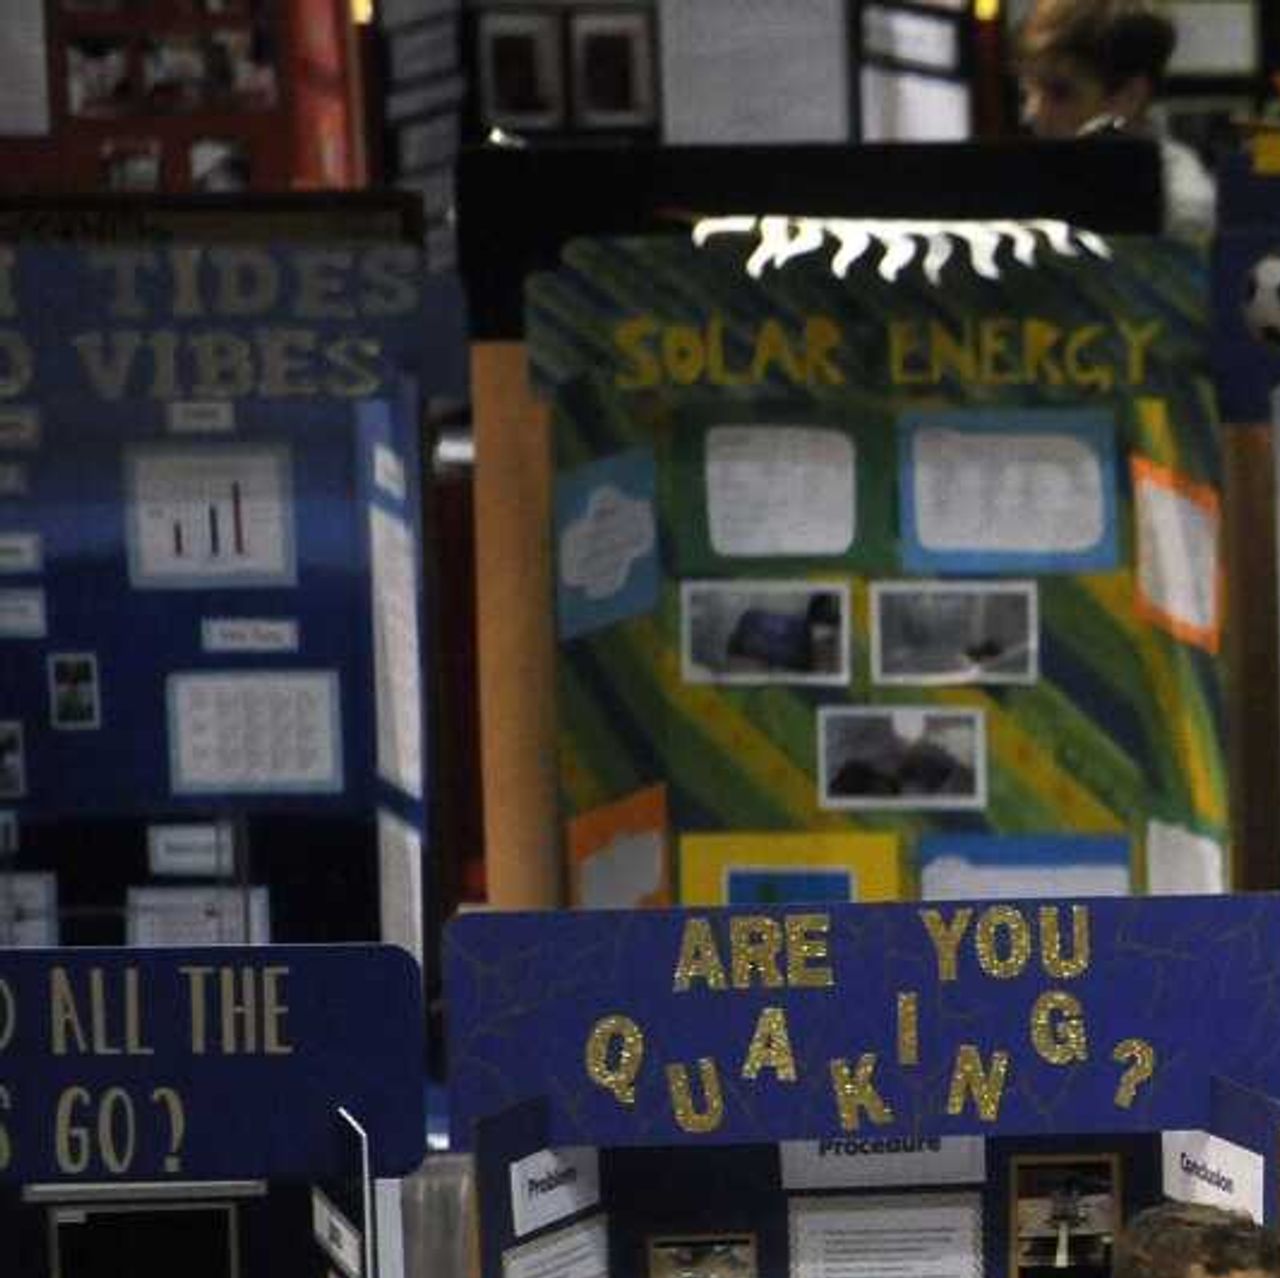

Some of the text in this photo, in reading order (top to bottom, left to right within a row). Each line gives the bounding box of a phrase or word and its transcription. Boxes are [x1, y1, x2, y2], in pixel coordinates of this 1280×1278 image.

[92, 244, 419, 318] TIDES
[71, 327, 384, 398] VIBES
[614, 314, 1161, 392] SOLAR ENERGY
[673, 906, 1094, 993] ARE YOU
[51, 966, 155, 1056] ALL
[180, 966, 294, 1056] THE
[56, 1085, 186, 1174] GO?
[1179, 1151, 1236, 1195] Conclusion
